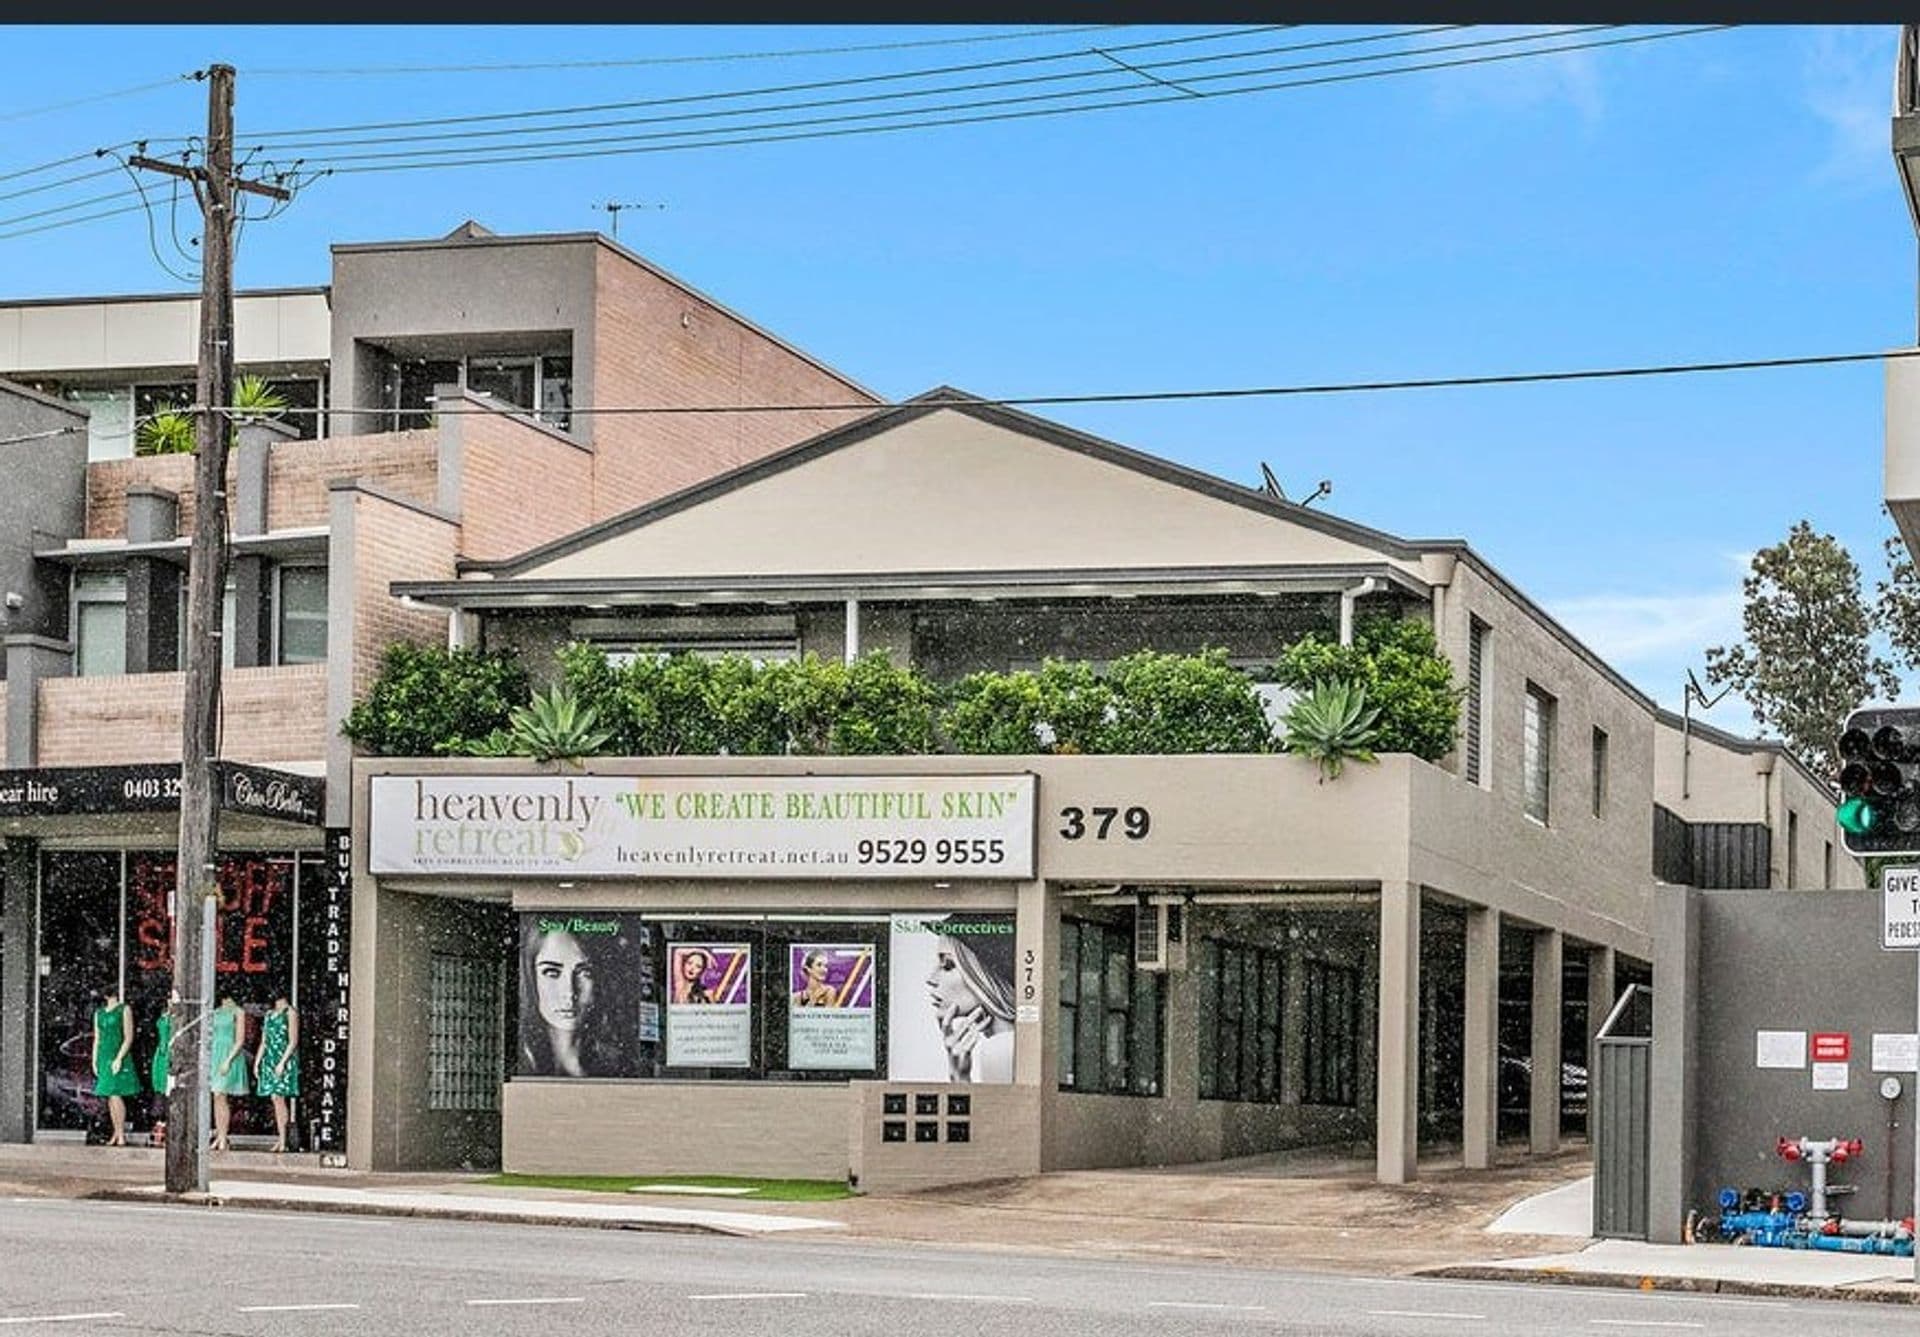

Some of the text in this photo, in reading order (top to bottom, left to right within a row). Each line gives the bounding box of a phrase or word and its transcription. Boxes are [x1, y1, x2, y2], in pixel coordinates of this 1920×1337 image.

[27, 780, 58, 802] hire
[124, 779, 160, 798] 0403
[415, 780, 600, 832] heavenly
[676, 792, 776, 819] CREATE
[786, 792, 932, 819] BEAUTIFUL
[415, 823, 552, 855] retreat
[1060, 807, 1150, 840] 379
[338, 835, 350, 885] BUY
[617, 839, 1005, 867] heavenlyretreat.net.au 9529 9555
[1887, 876, 1919, 893] GIVE
[1911, 899, 1920, 915] T
[327, 887, 340, 972] TRADE
[895, 919, 1014, 935] Skin Correctives
[138, 917, 267, 972] SLE
[337, 972, 349, 1040] HIRE
[321, 1039, 336, 1142] DONATE
